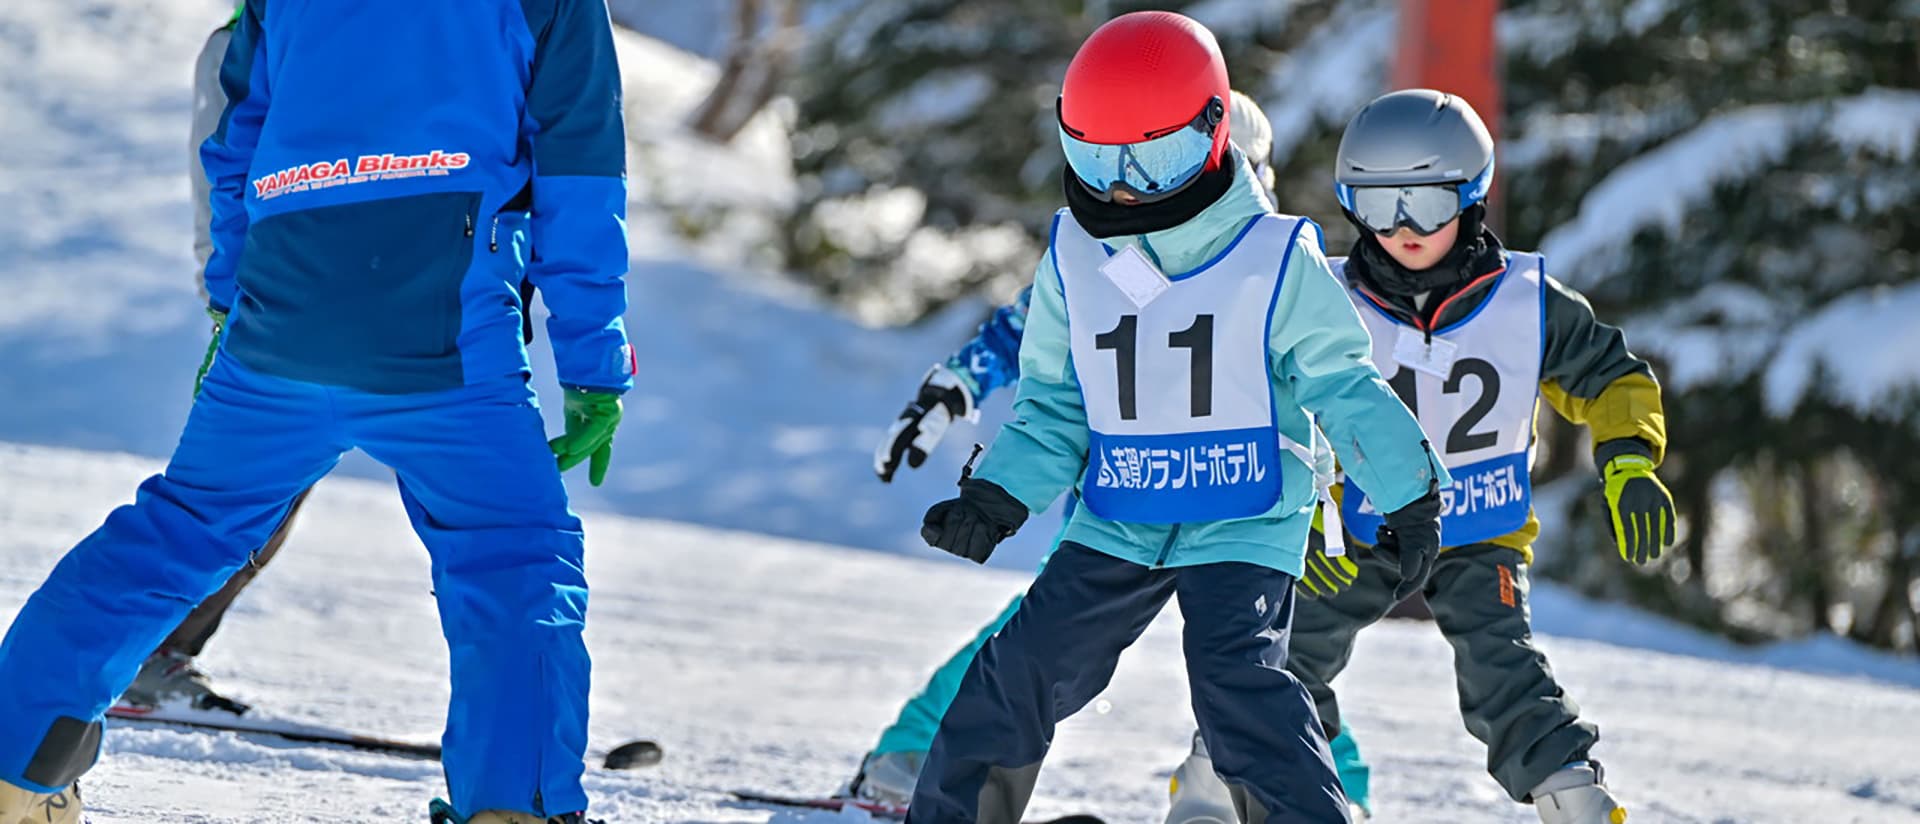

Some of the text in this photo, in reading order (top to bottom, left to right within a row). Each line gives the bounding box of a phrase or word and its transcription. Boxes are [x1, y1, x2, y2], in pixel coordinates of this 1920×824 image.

[254, 158, 350, 197] YAMAGA
[356, 151, 470, 173] Blanks
[1095, 314, 1214, 420] 11
